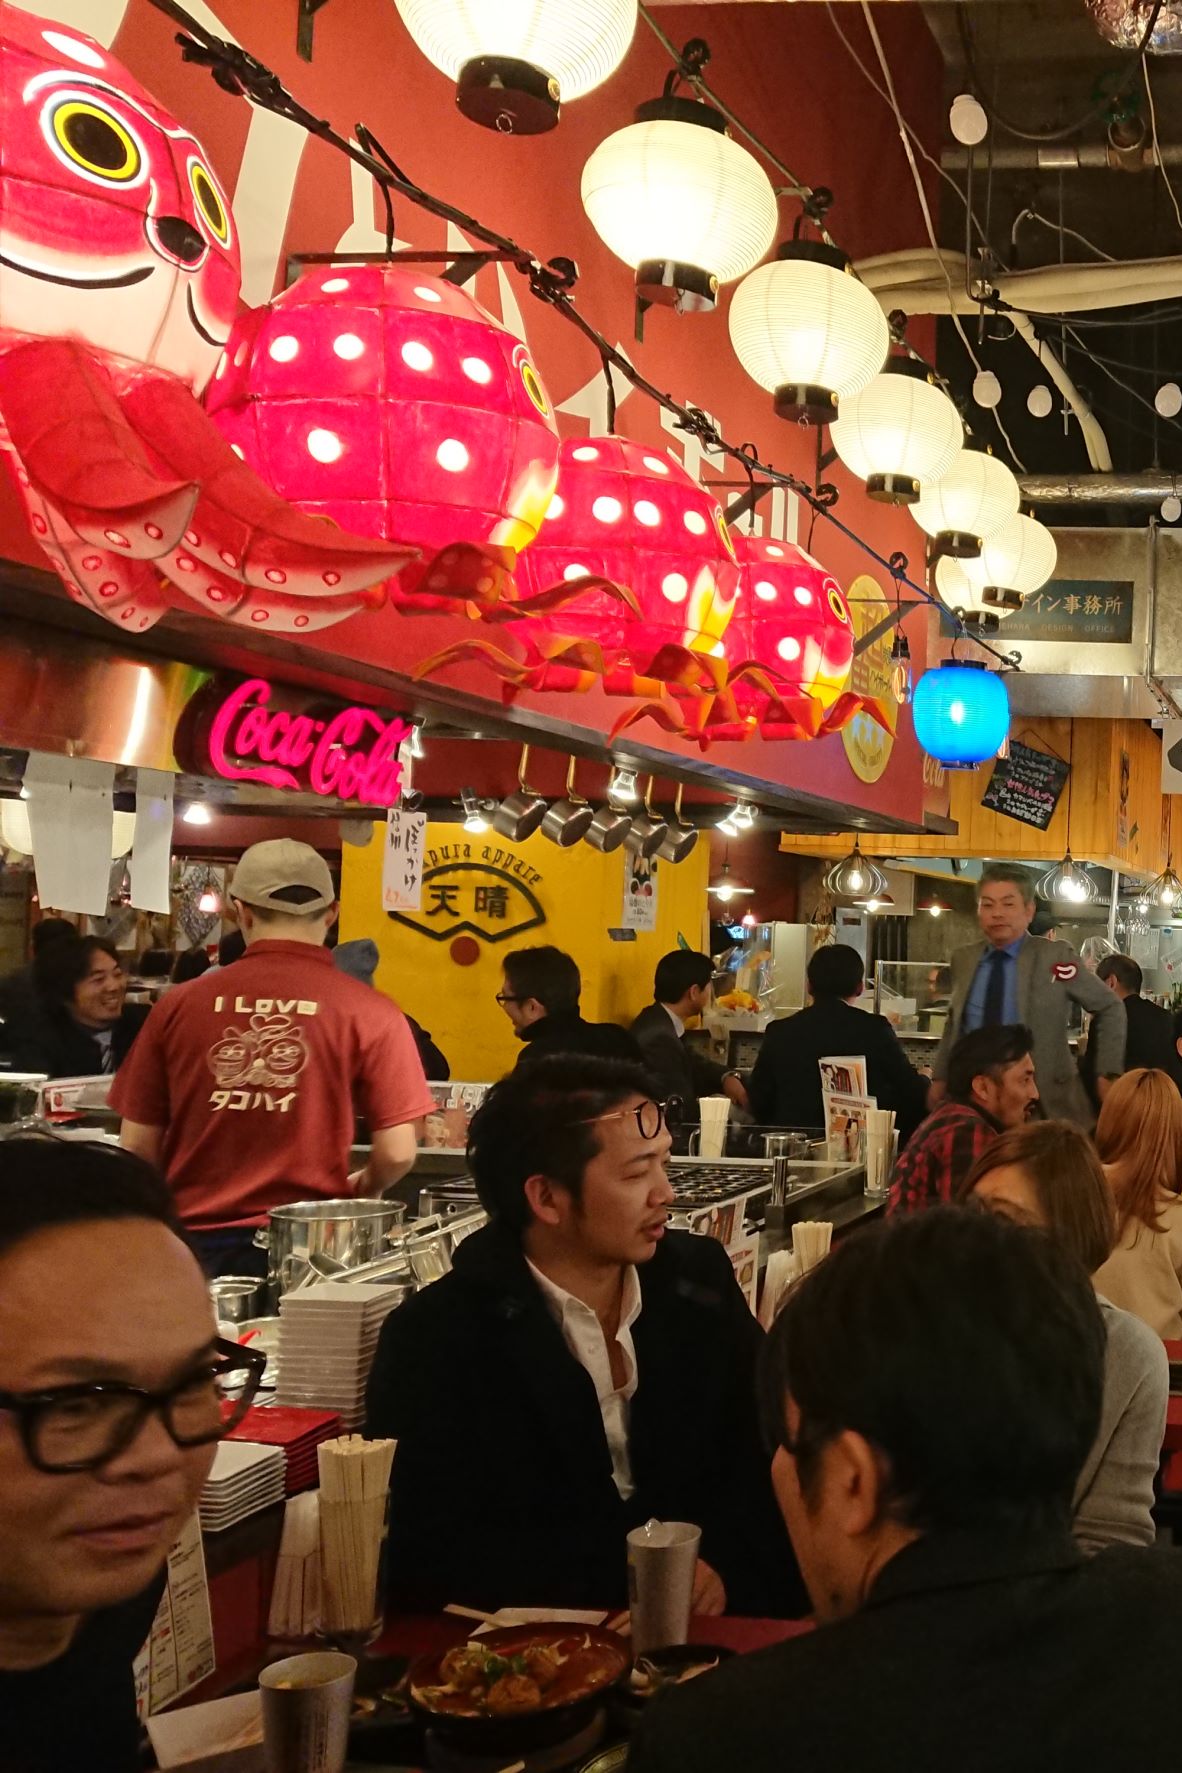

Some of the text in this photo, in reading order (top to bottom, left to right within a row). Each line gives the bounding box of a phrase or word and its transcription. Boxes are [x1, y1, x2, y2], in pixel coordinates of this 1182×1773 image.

[425, 884, 509, 918] 天晴
[214, 996, 224, 1013] I
[208, 1090, 297, 1112] タコハイ
